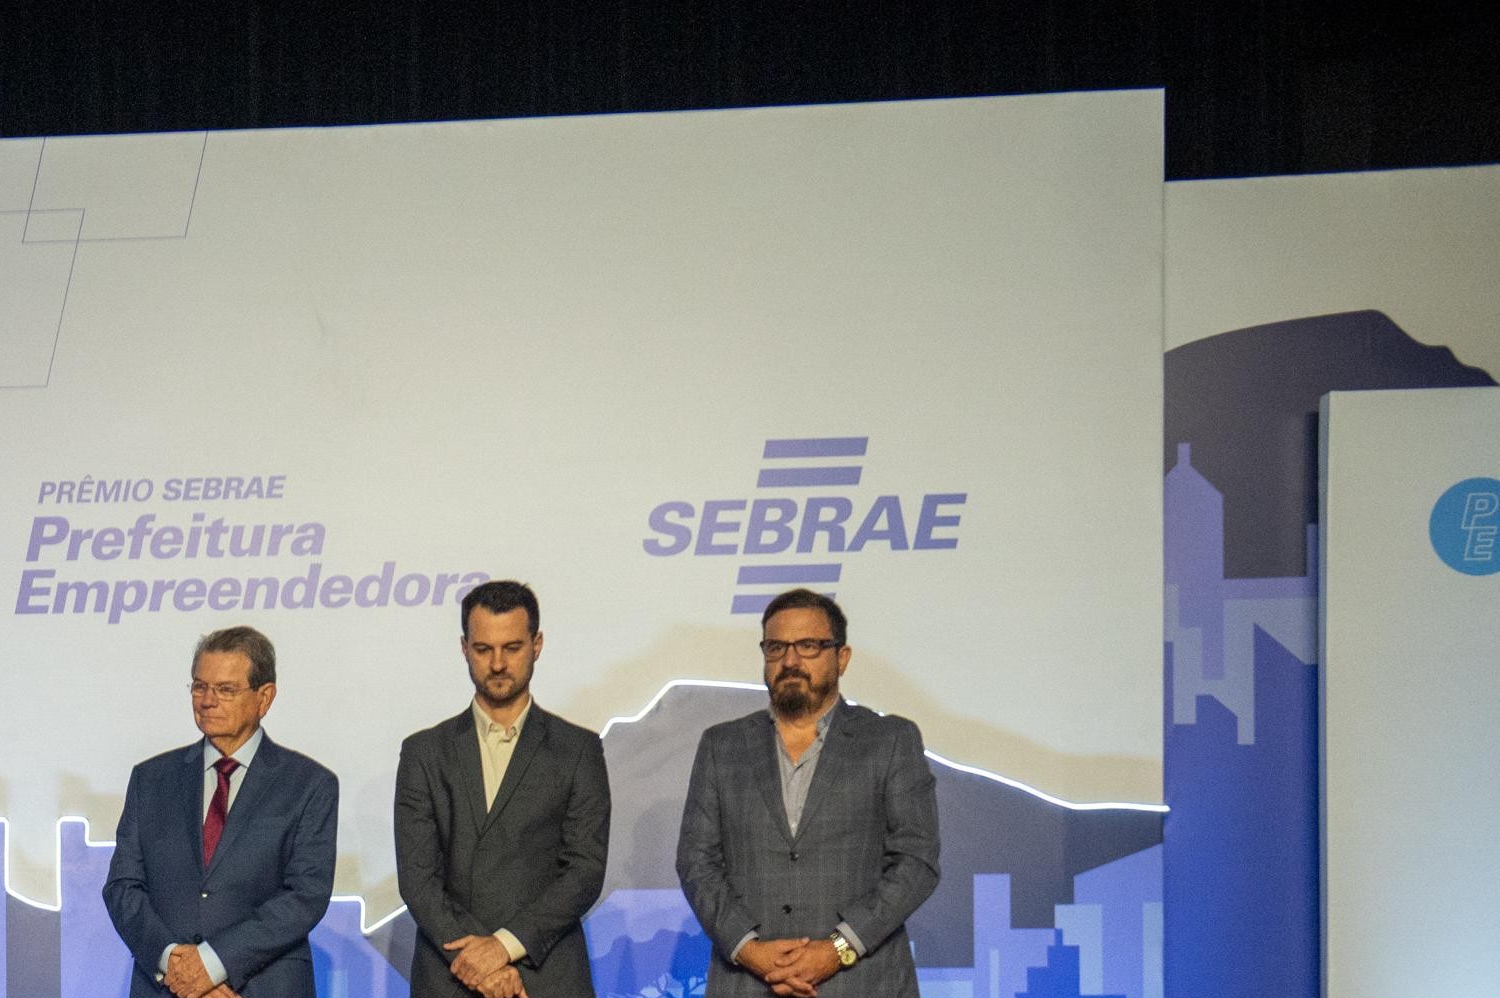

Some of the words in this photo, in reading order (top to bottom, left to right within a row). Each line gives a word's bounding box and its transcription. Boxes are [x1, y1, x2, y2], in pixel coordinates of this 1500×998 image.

[38, 474, 154, 504] PRÊMIO
[161, 475, 286, 501] SEBRAE
[26, 512, 326, 562] Prefeitura
[642, 493, 967, 557] SEBRAE
